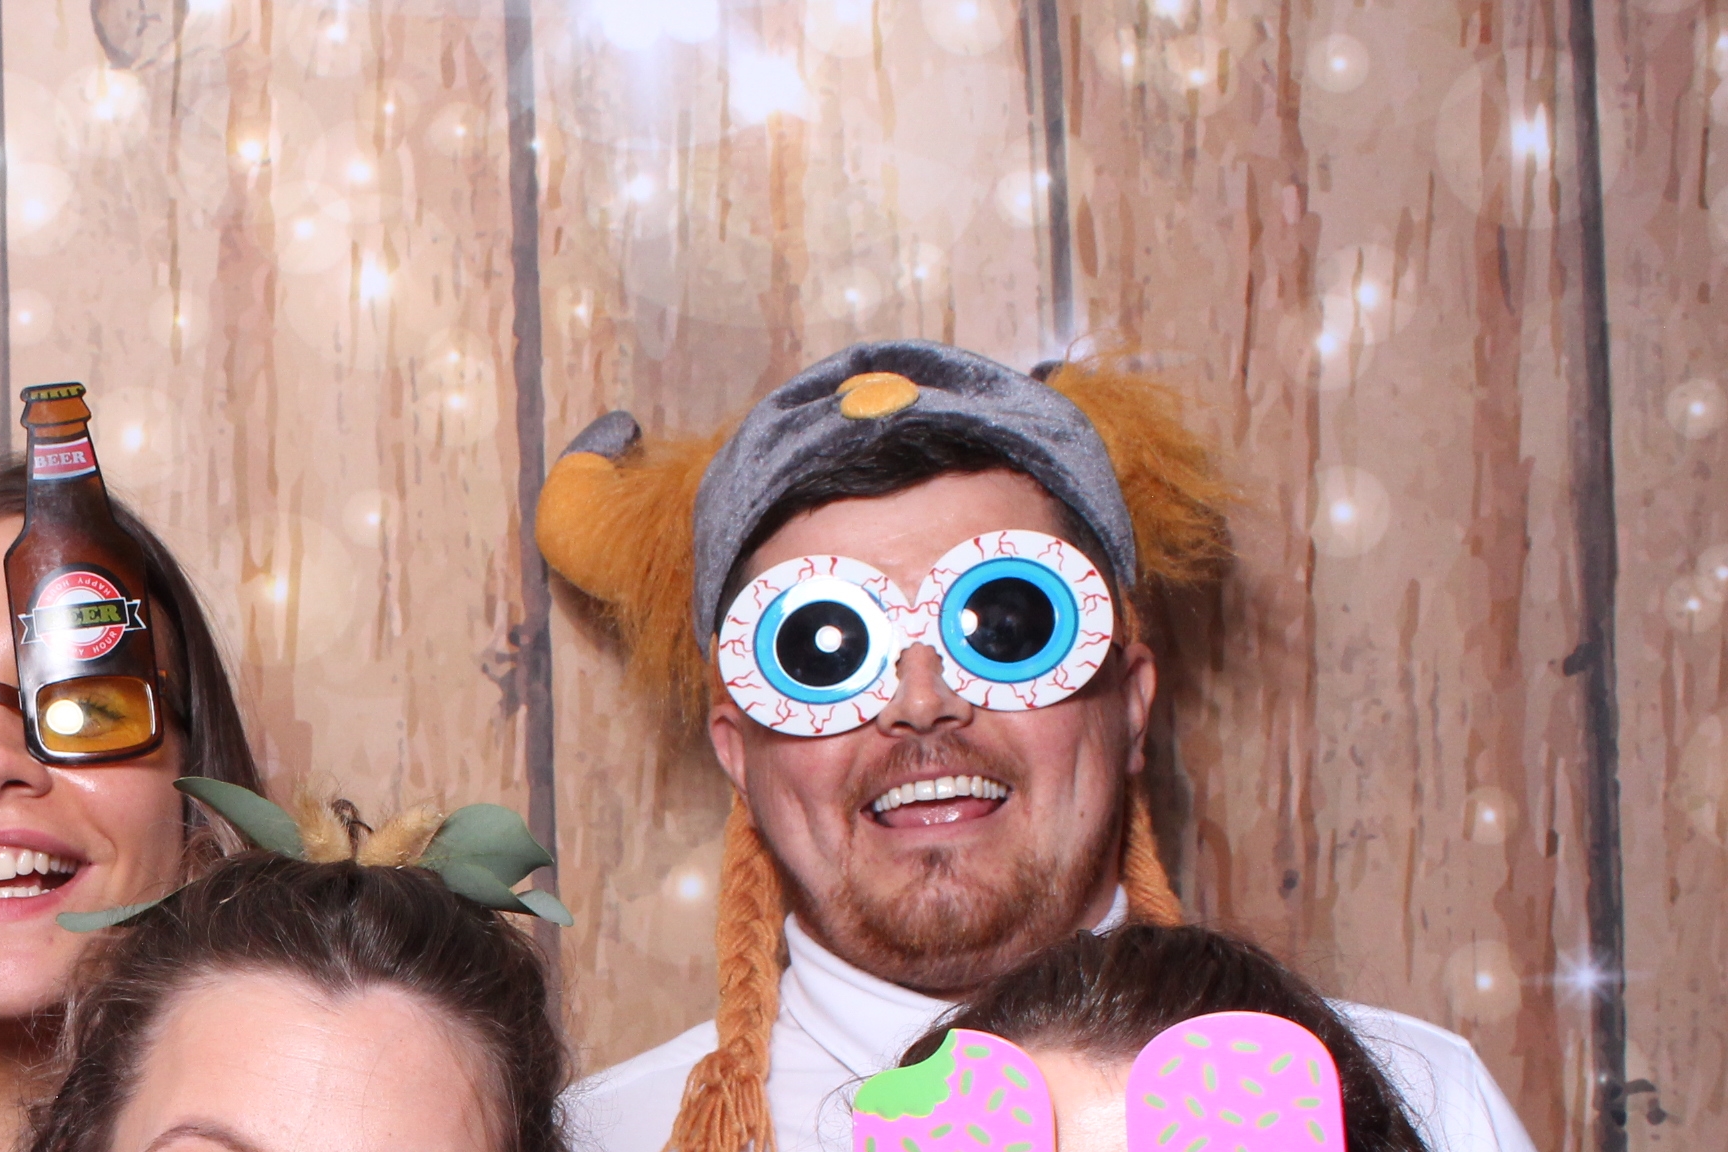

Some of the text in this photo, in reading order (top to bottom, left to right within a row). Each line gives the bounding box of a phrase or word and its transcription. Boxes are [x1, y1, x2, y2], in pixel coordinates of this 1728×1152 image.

[34, 450, 86, 469] BEER
[45, 577, 111, 601] HAPPY HOUR
[45, 604, 122, 627] EER
[92, 630, 117, 653] HOUR
